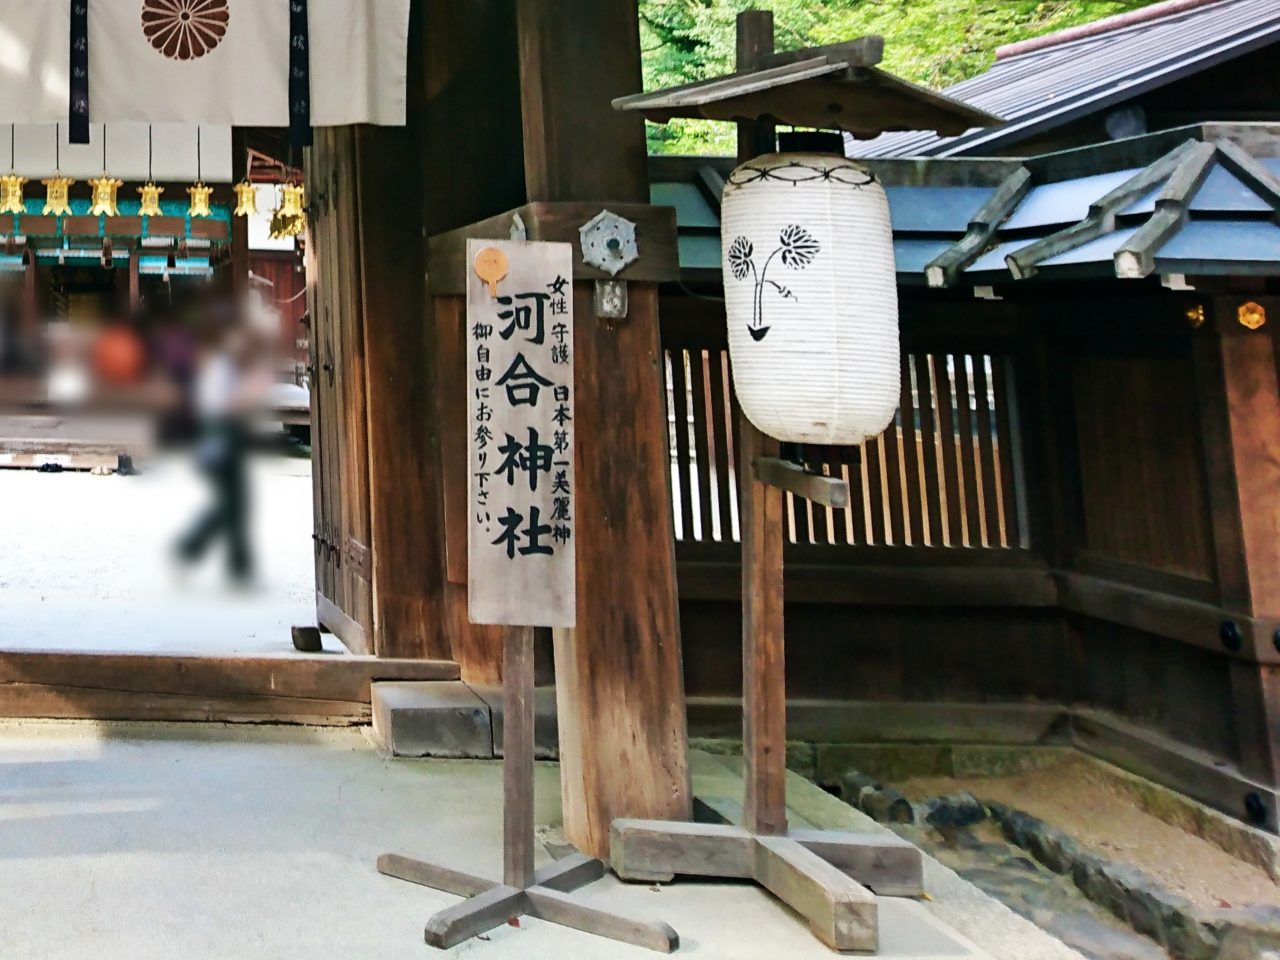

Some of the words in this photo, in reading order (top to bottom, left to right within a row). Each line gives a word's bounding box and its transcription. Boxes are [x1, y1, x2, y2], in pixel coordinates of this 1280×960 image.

[546, 274, 570, 365] 女性守護
[491, 291, 555, 560] 河合神社
